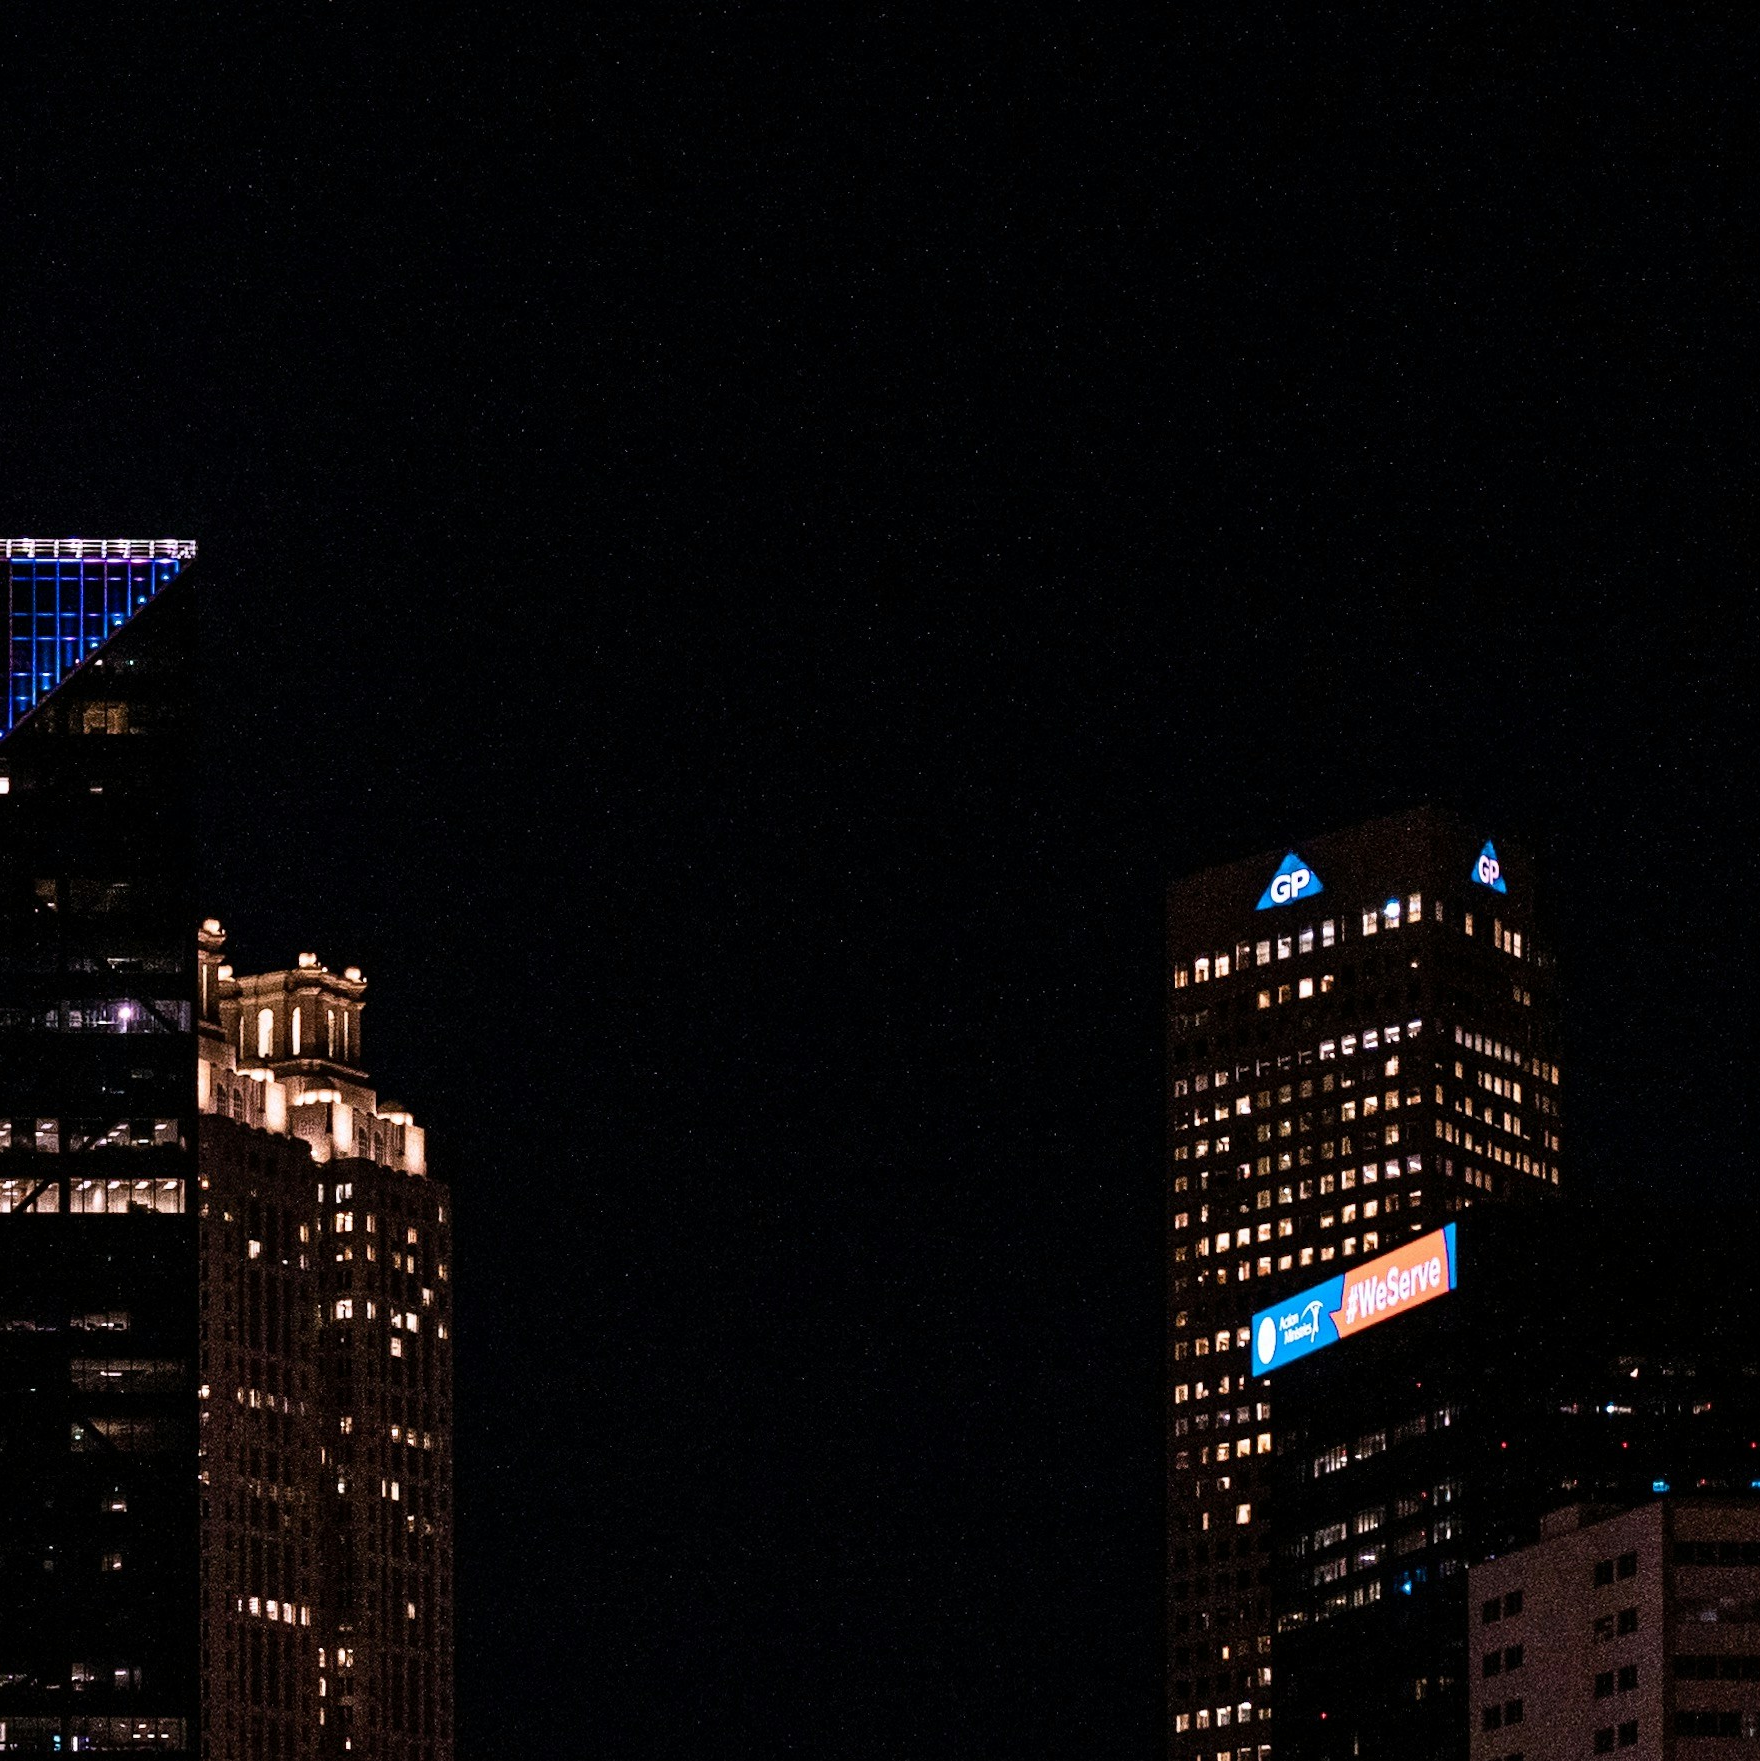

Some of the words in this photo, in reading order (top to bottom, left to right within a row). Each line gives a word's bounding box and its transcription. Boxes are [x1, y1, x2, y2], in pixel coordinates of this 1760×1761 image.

[1270, 868, 1311, 904] GP
[1478, 854, 1500, 885] GP
[1345, 1256, 1442, 1325] #WeServe
